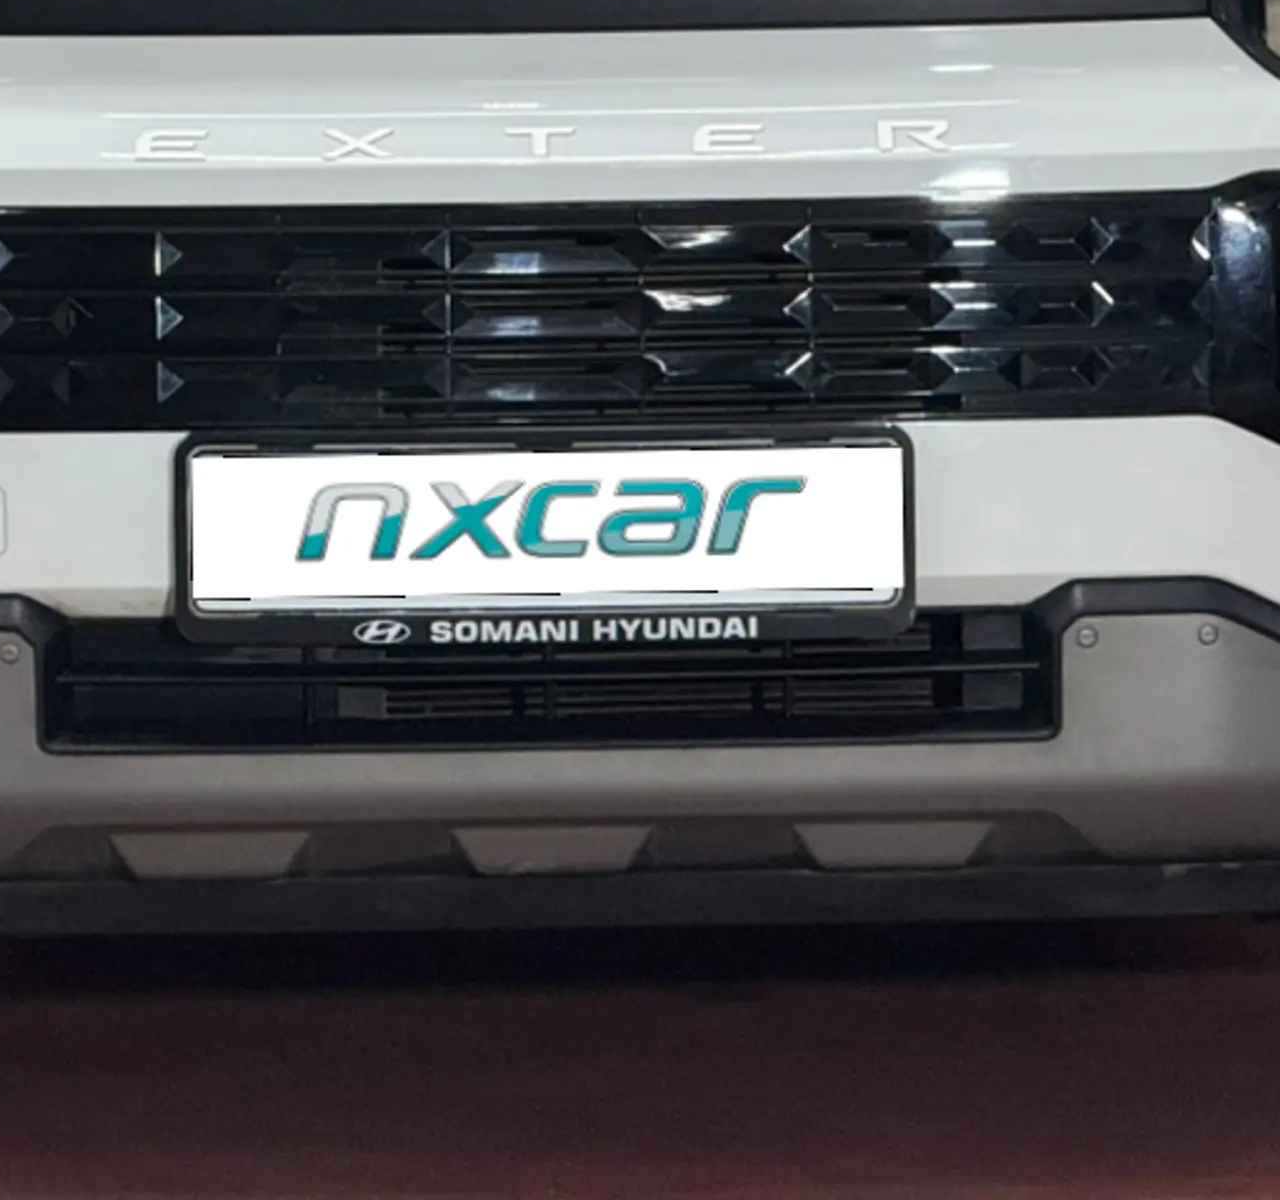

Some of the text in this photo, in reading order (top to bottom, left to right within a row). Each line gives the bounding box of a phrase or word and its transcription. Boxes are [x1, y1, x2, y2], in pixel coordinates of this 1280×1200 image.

[134, 120, 951, 161] EXTER
[429, 616, 759, 644] SOMANI HYUNDAI
